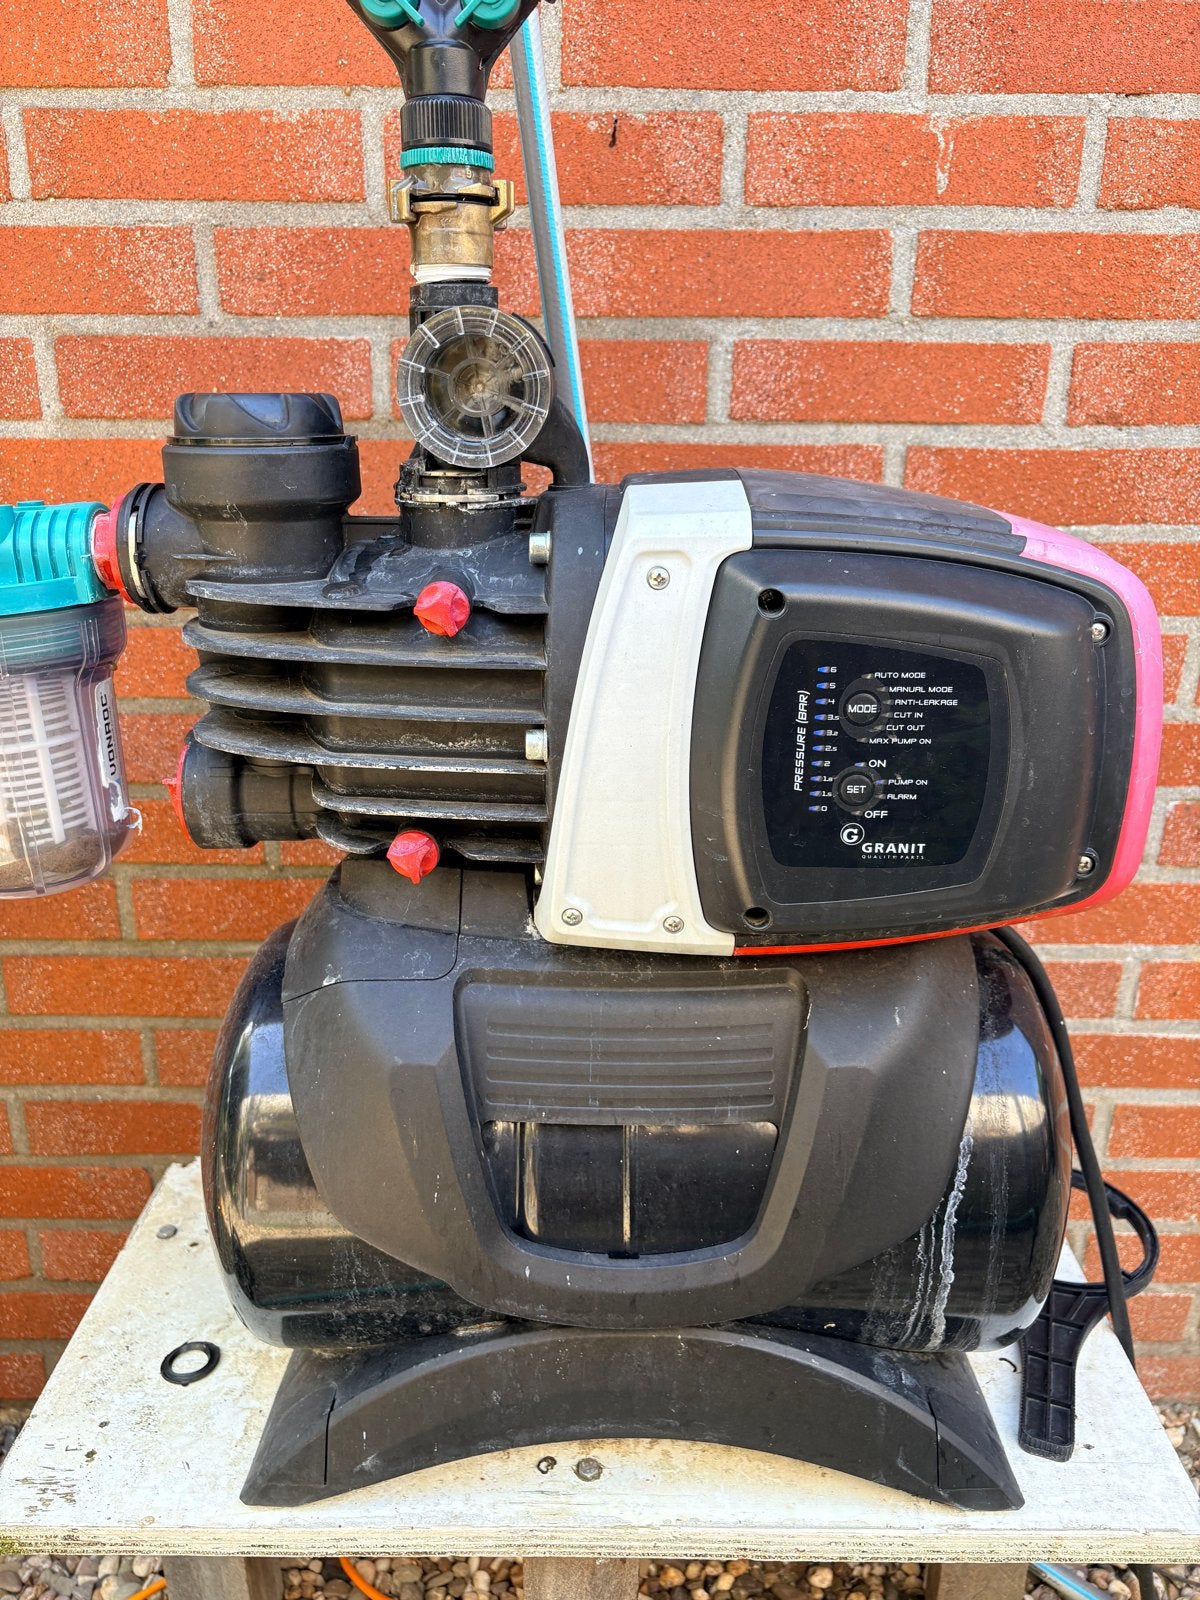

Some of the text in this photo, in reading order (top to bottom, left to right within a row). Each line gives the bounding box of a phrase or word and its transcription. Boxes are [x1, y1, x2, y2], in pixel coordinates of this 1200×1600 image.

[847, 704, 878, 714] MODE
[100, 694, 117, 776] VONROC
[794, 690, 811, 792] PRESSURE (BAR)
[868, 759, 887, 768] ON
[846, 785, 867, 794] SET
[864, 810, 889, 819] OFF
[861, 842, 926, 854] GRANIT
